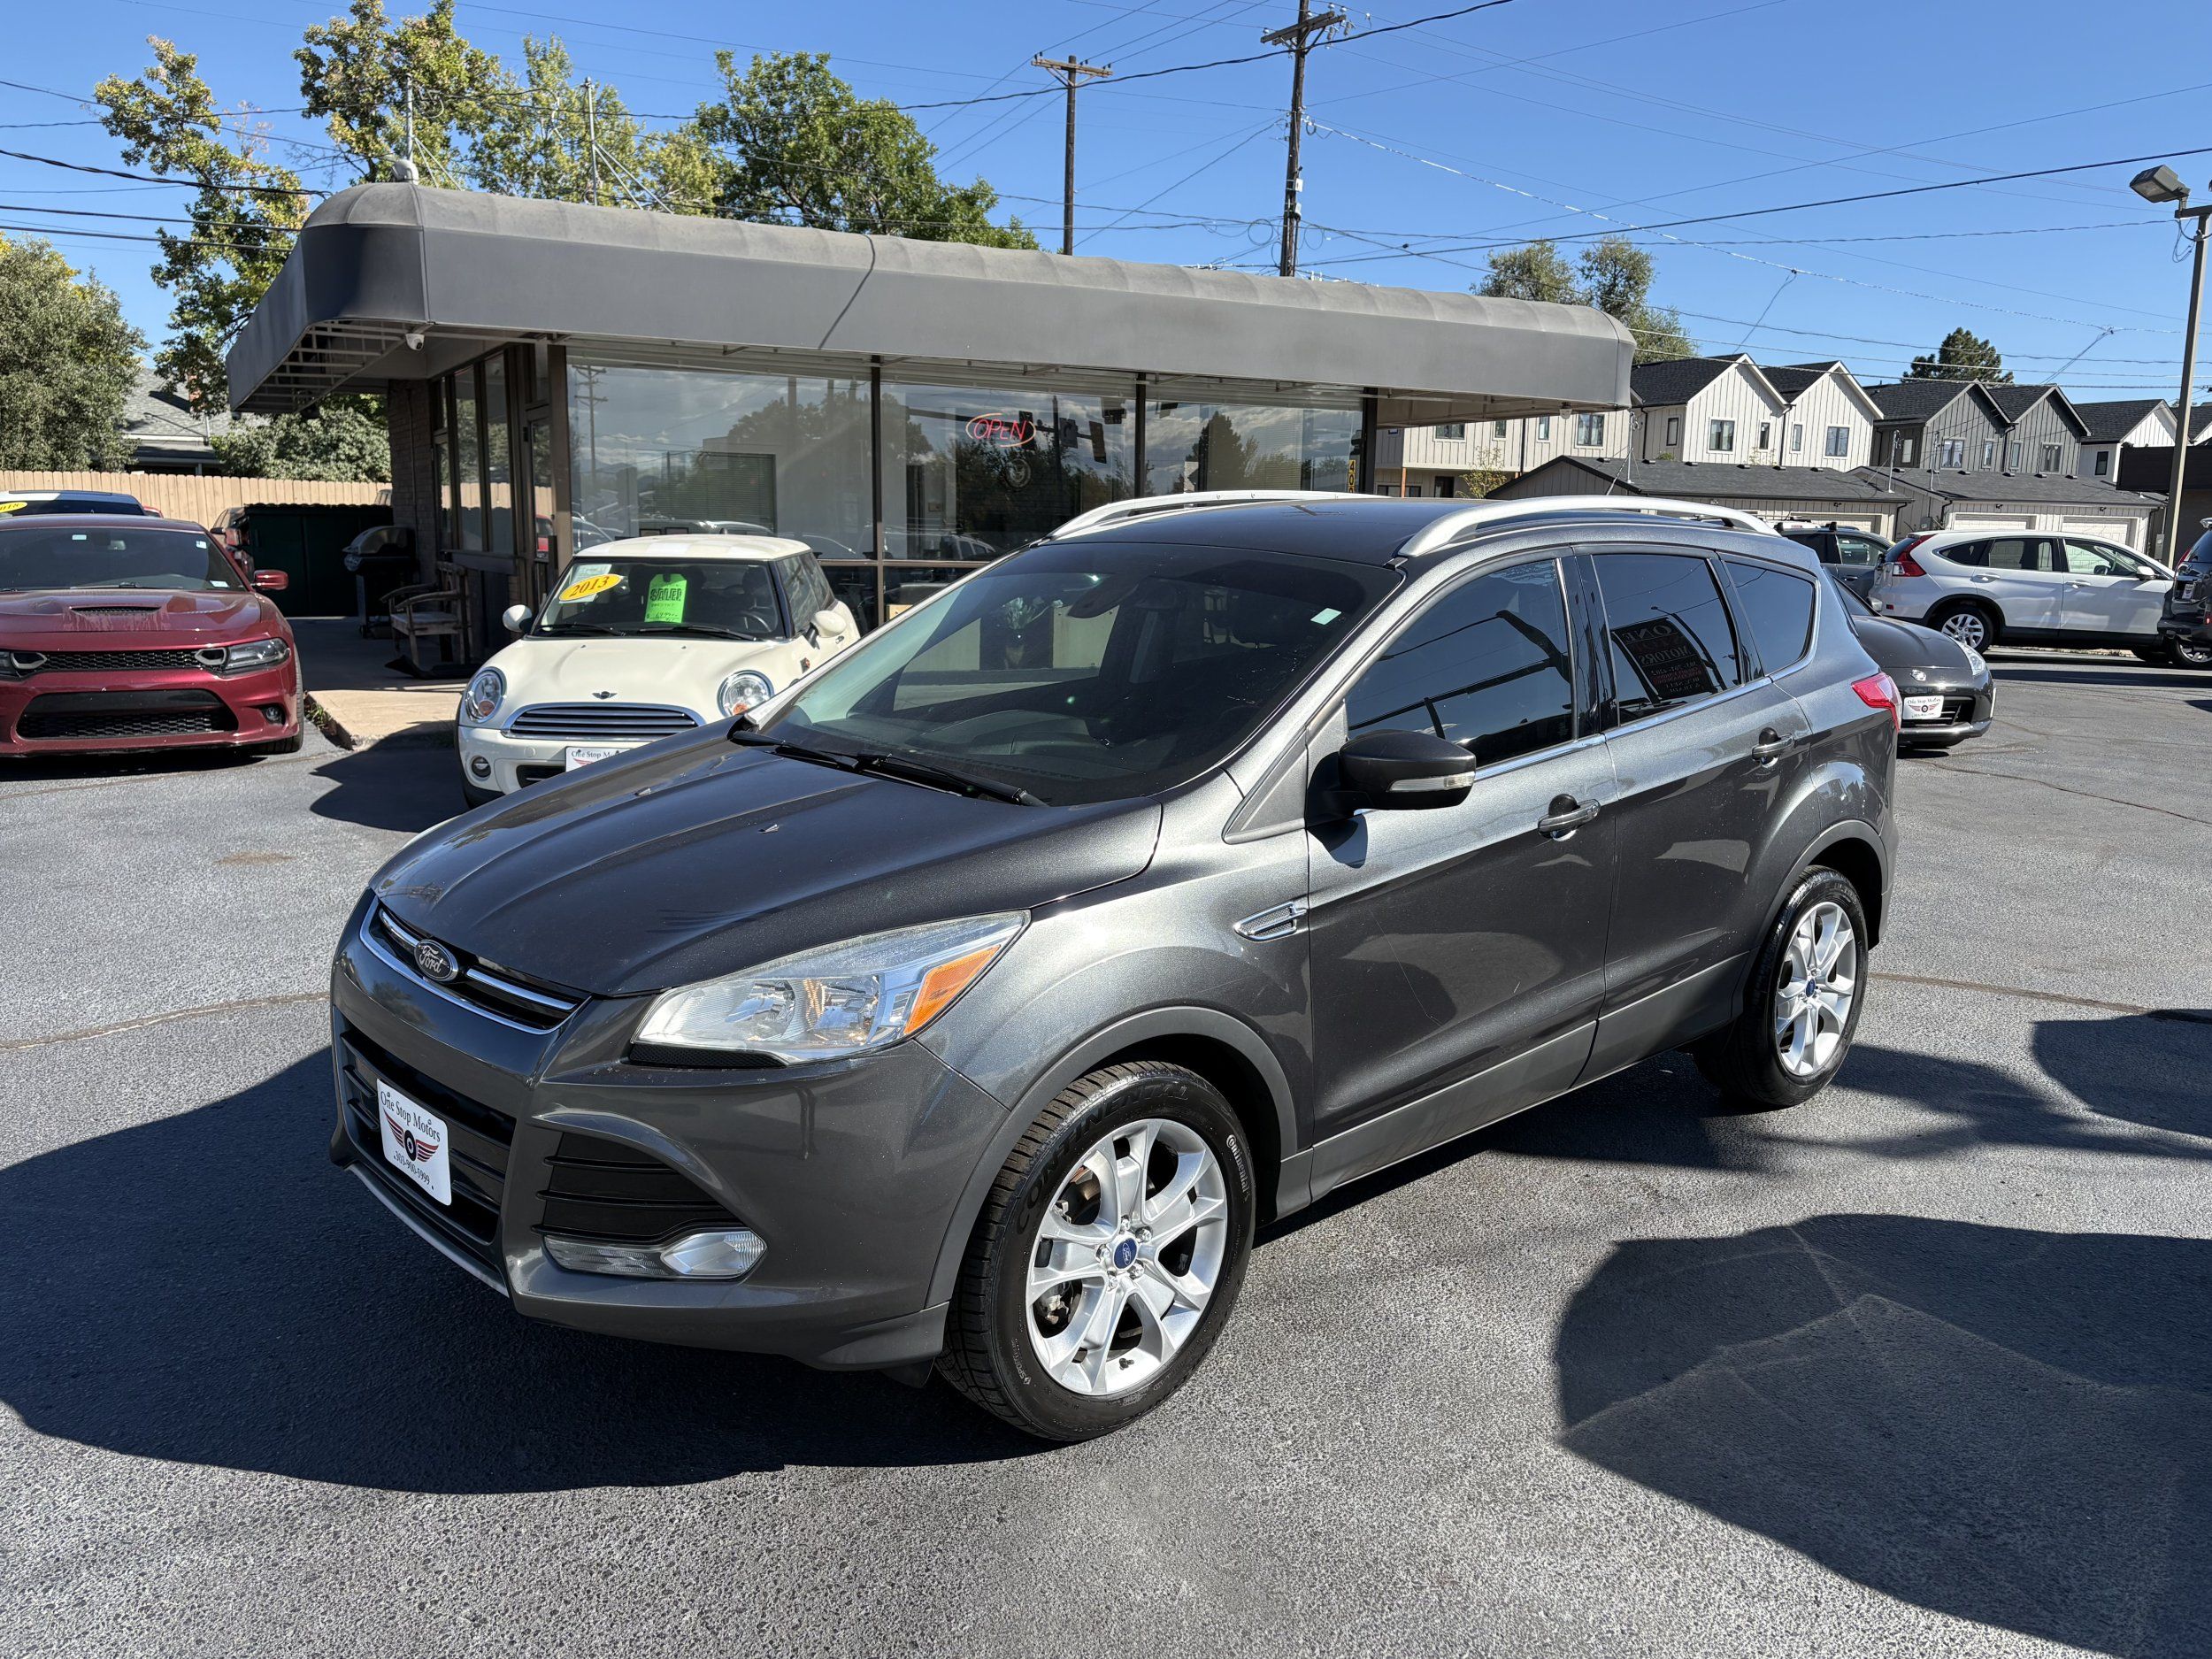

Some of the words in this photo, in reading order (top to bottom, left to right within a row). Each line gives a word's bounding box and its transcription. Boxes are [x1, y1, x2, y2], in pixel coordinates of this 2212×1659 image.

[974, 419, 1027, 440] OPEN
[569, 576, 609, 597] 2013
[419, 945, 449, 973] Ford
[380, 1091, 395, 1111] One
[396, 1101, 411, 1126] Stop
[413, 1112, 441, 1142] Motors
